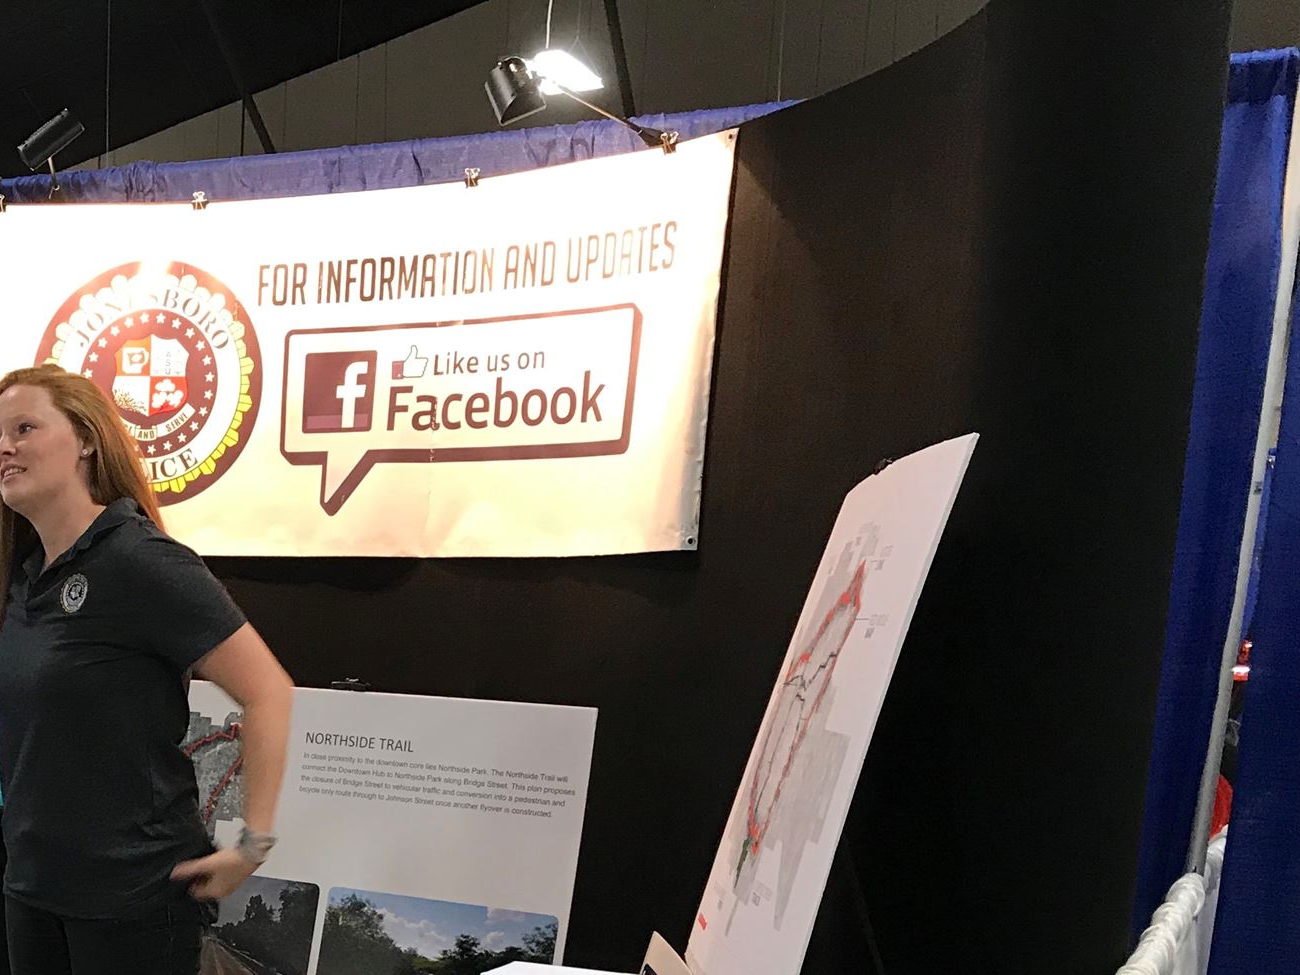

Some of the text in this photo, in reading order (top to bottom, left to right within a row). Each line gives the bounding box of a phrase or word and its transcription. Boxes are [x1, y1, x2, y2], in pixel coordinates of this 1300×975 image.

[258, 220, 677, 306] FOR INFORMATION AND UPDATES
[77, 288, 230, 350] JOBORO
[432, 349, 546, 376] Like us on
[386, 376, 605, 433] Facebook
[150, 448, 199, 482] ICE
[305, 731, 414, 753] NORTHSIDE TRAIL
[327, 765, 337, 773] the
[338, 766, 371, 776] Downtown
[372, 769, 385, 777] Hub
[395, 771, 426, 781] Northside
[427, 774, 442, 783] Park
[444, 777, 462, 786] along
[463, 778, 485, 788] Bridge
[511, 782, 526, 791] This
[527, 784, 542, 793] plan
[543, 787, 576, 796] proposes
[376, 758, 408, 768] downtown
[439, 764, 471, 774] Northside
[491, 768, 504, 777] The
[505, 770, 539, 780] Northside
[540, 773, 555, 782] Trail
